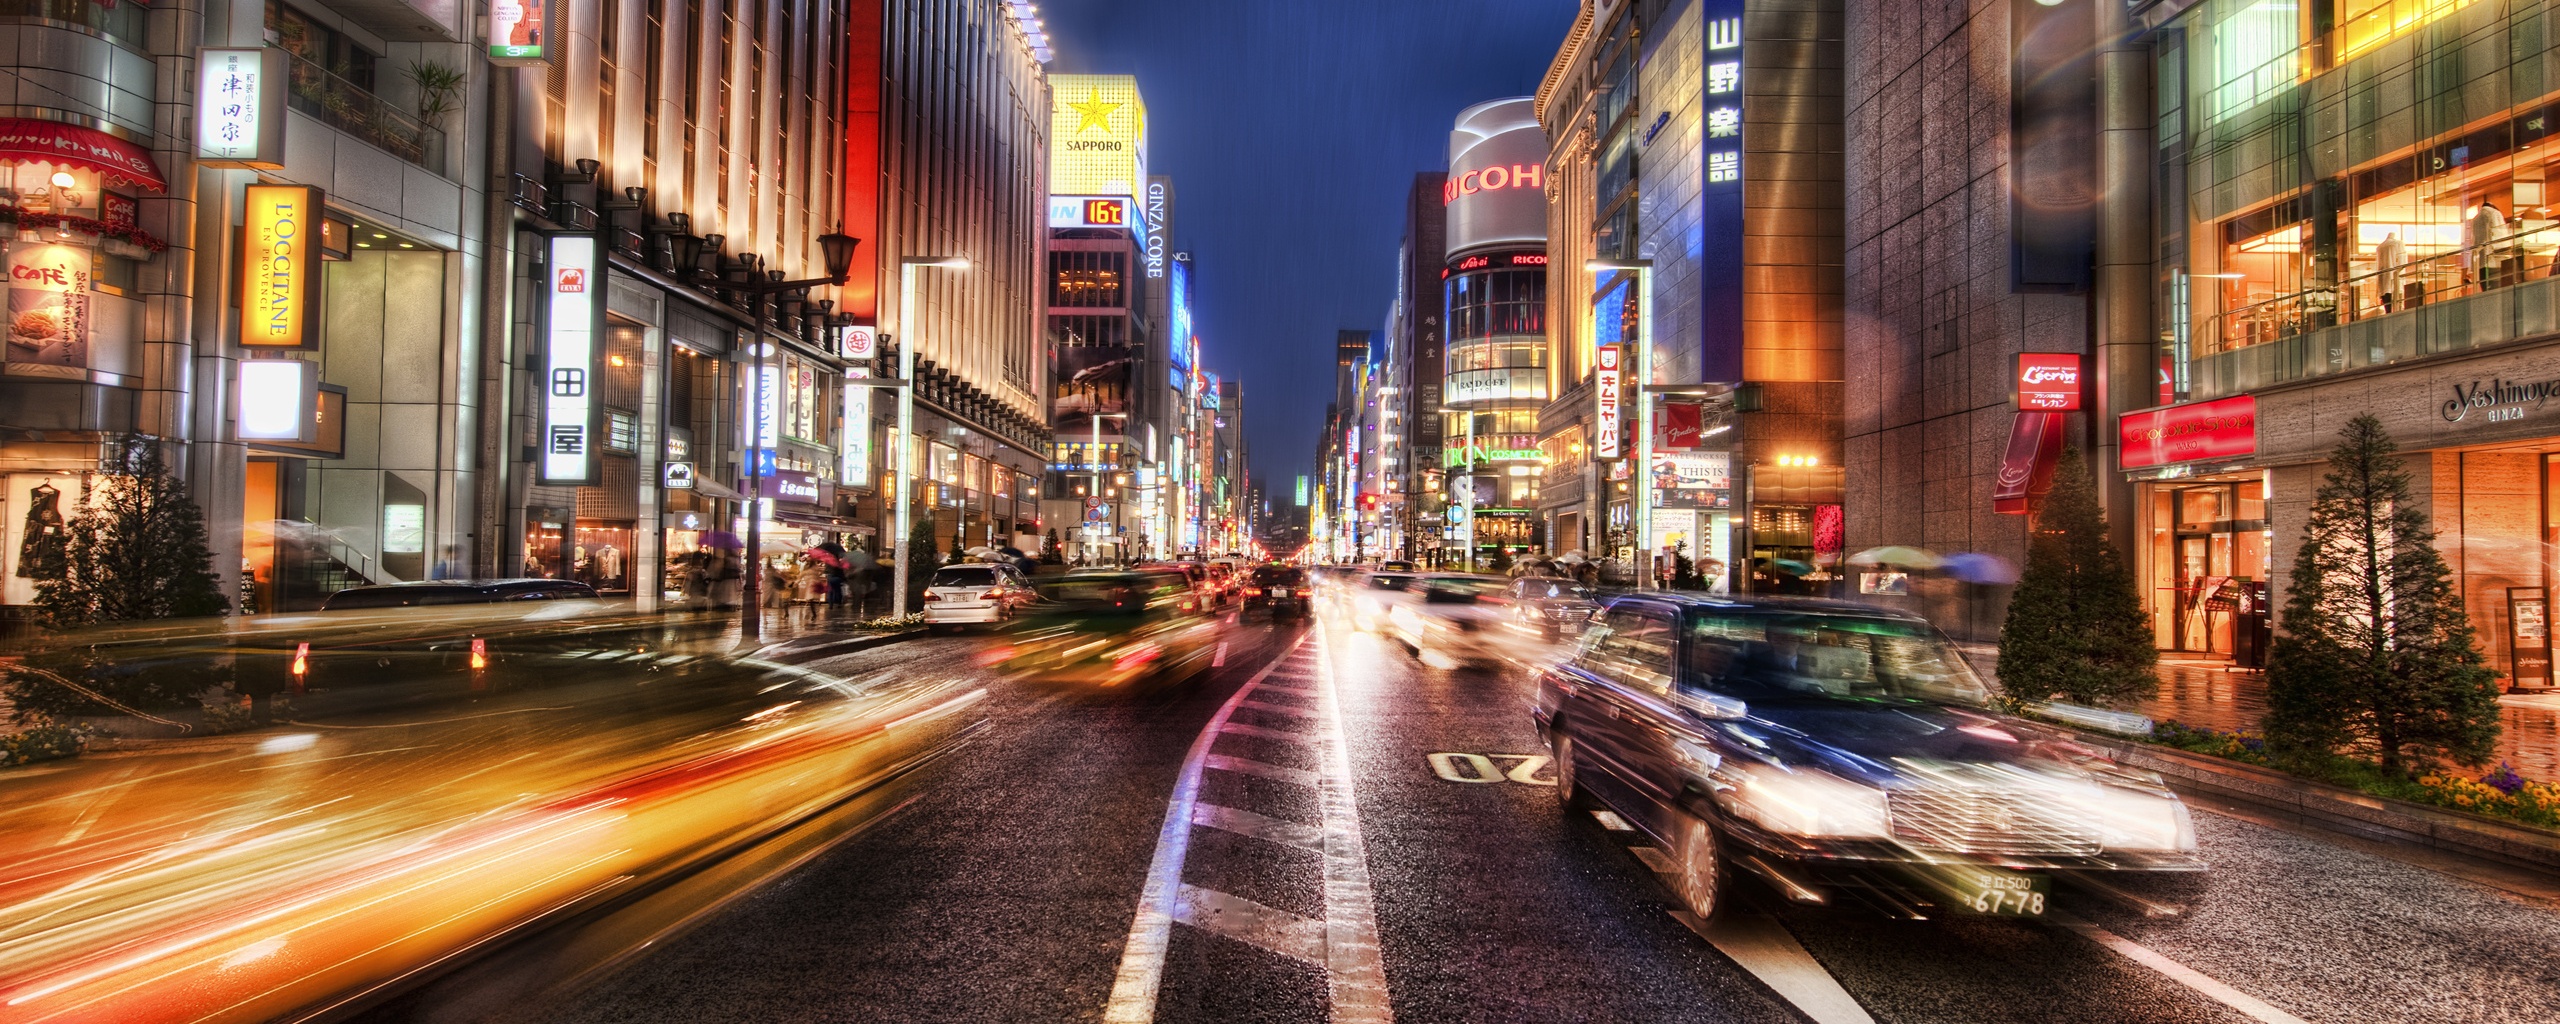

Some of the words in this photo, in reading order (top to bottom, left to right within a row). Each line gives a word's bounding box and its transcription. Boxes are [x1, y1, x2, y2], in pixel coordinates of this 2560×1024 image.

[227, 55, 238, 72] 銀座
[506, 46, 529, 56] 3F
[245, 73, 255, 123] 和装小もの
[1710, 17, 1740, 183] 山野楽器
[222, 147, 238, 156] 1F
[1066, 140, 1122, 151] SAPPORO
[1444, 164, 1541, 206] RICOH
[1148, 183, 1164, 233] GINZA
[263, 227, 271, 242] EN
[270, 203, 296, 336] L'OCCITANE
[1147, 235, 1164, 279] CORE
[259, 248, 270, 312] PROVENCE
[1424, 315, 1437, 359] 鳩居堂
[1457, 379, 1482, 389] RAND
[550, 367, 585, 455] 田屋
[1602, 376, 1617, 452] キムラヤのパン
[2442, 379, 2560, 422] Yoshinoya
[2488, 407, 2523, 422] GINZA
[1669, 425, 1699, 442] Fender
[2130, 421, 2203, 442] Chocolate
[2204, 414, 2249, 432] Shop
[1682, 467, 1709, 476] THIS
[1713, 467, 1723, 476] IS
[2006, 877, 2031, 890] 500
[1976, 890, 2044, 915] 67-78
